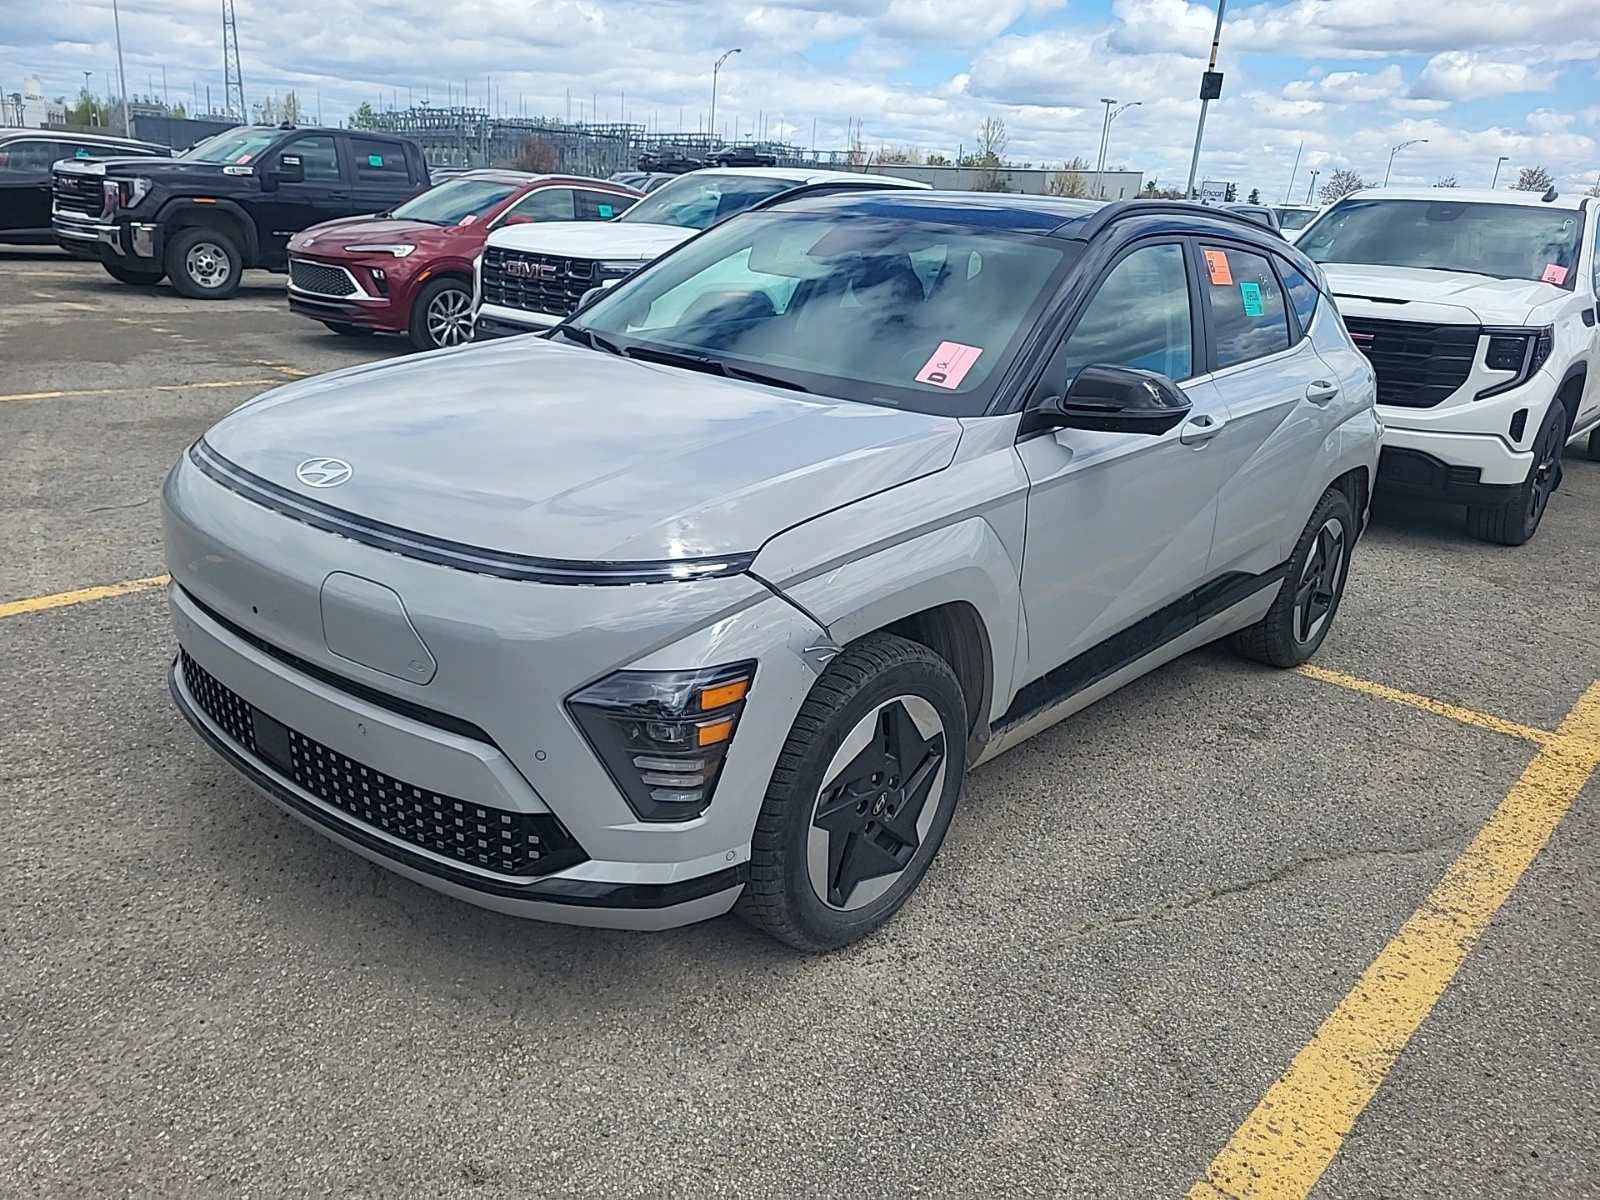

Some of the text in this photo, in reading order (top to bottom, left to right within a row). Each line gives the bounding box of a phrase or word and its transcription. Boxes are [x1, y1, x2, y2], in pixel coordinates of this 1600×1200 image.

[505, 260, 557, 281] GMC
[1208, 259, 1216, 273] B
[926, 372, 947, 383] D
